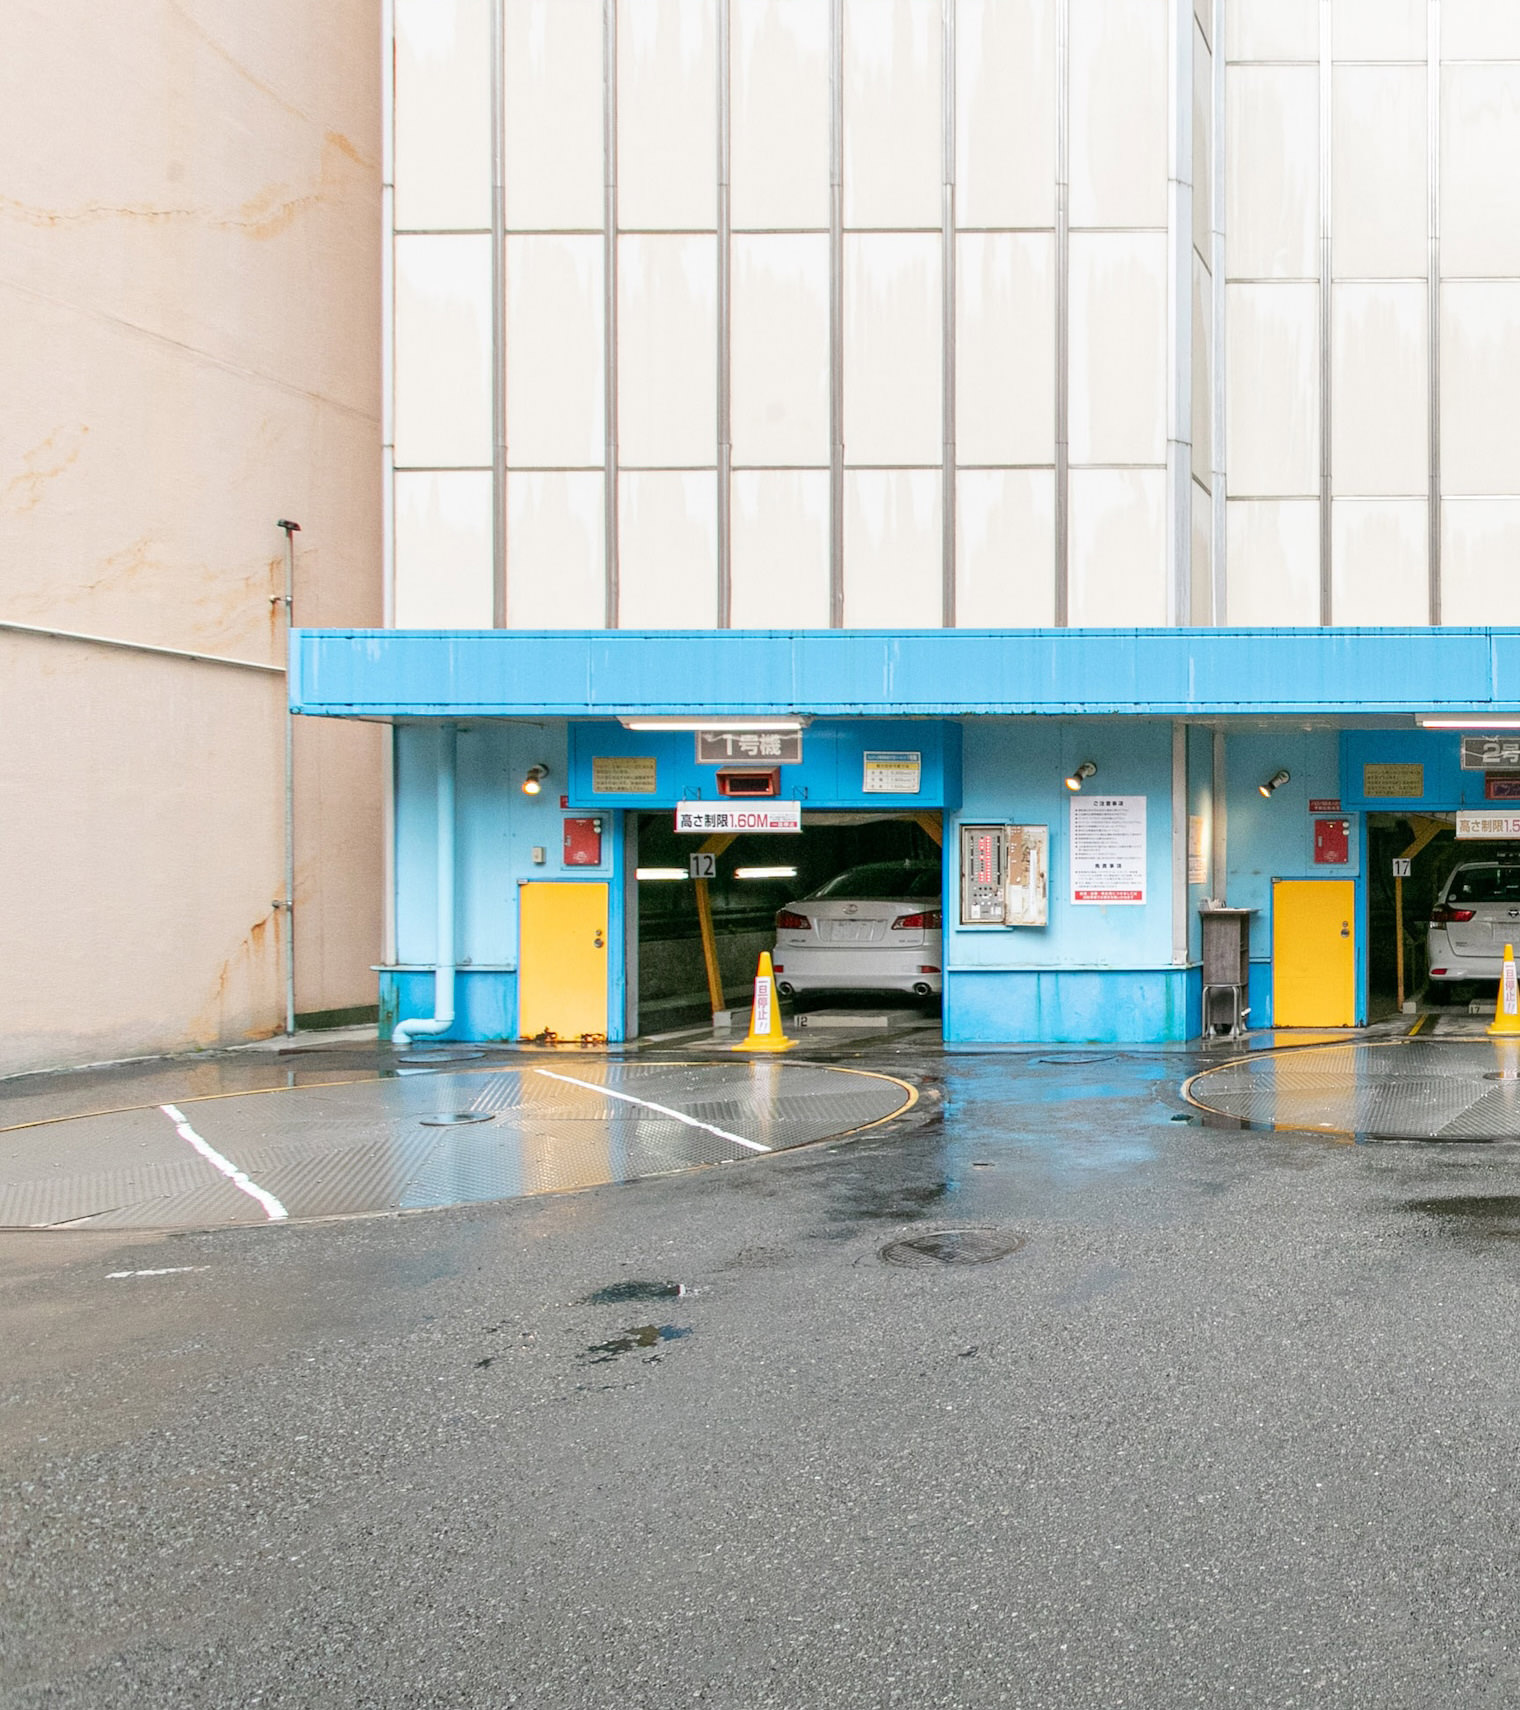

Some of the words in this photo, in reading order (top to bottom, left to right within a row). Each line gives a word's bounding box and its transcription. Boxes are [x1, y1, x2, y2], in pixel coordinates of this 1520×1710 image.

[723, 734, 782, 755] 1号機
[681, 814, 768, 828] 高さ制限1.60M
[693, 855, 714, 876] 12
[1394, 860, 1410, 875] 17
[796, 1016, 808, 1028] 12
